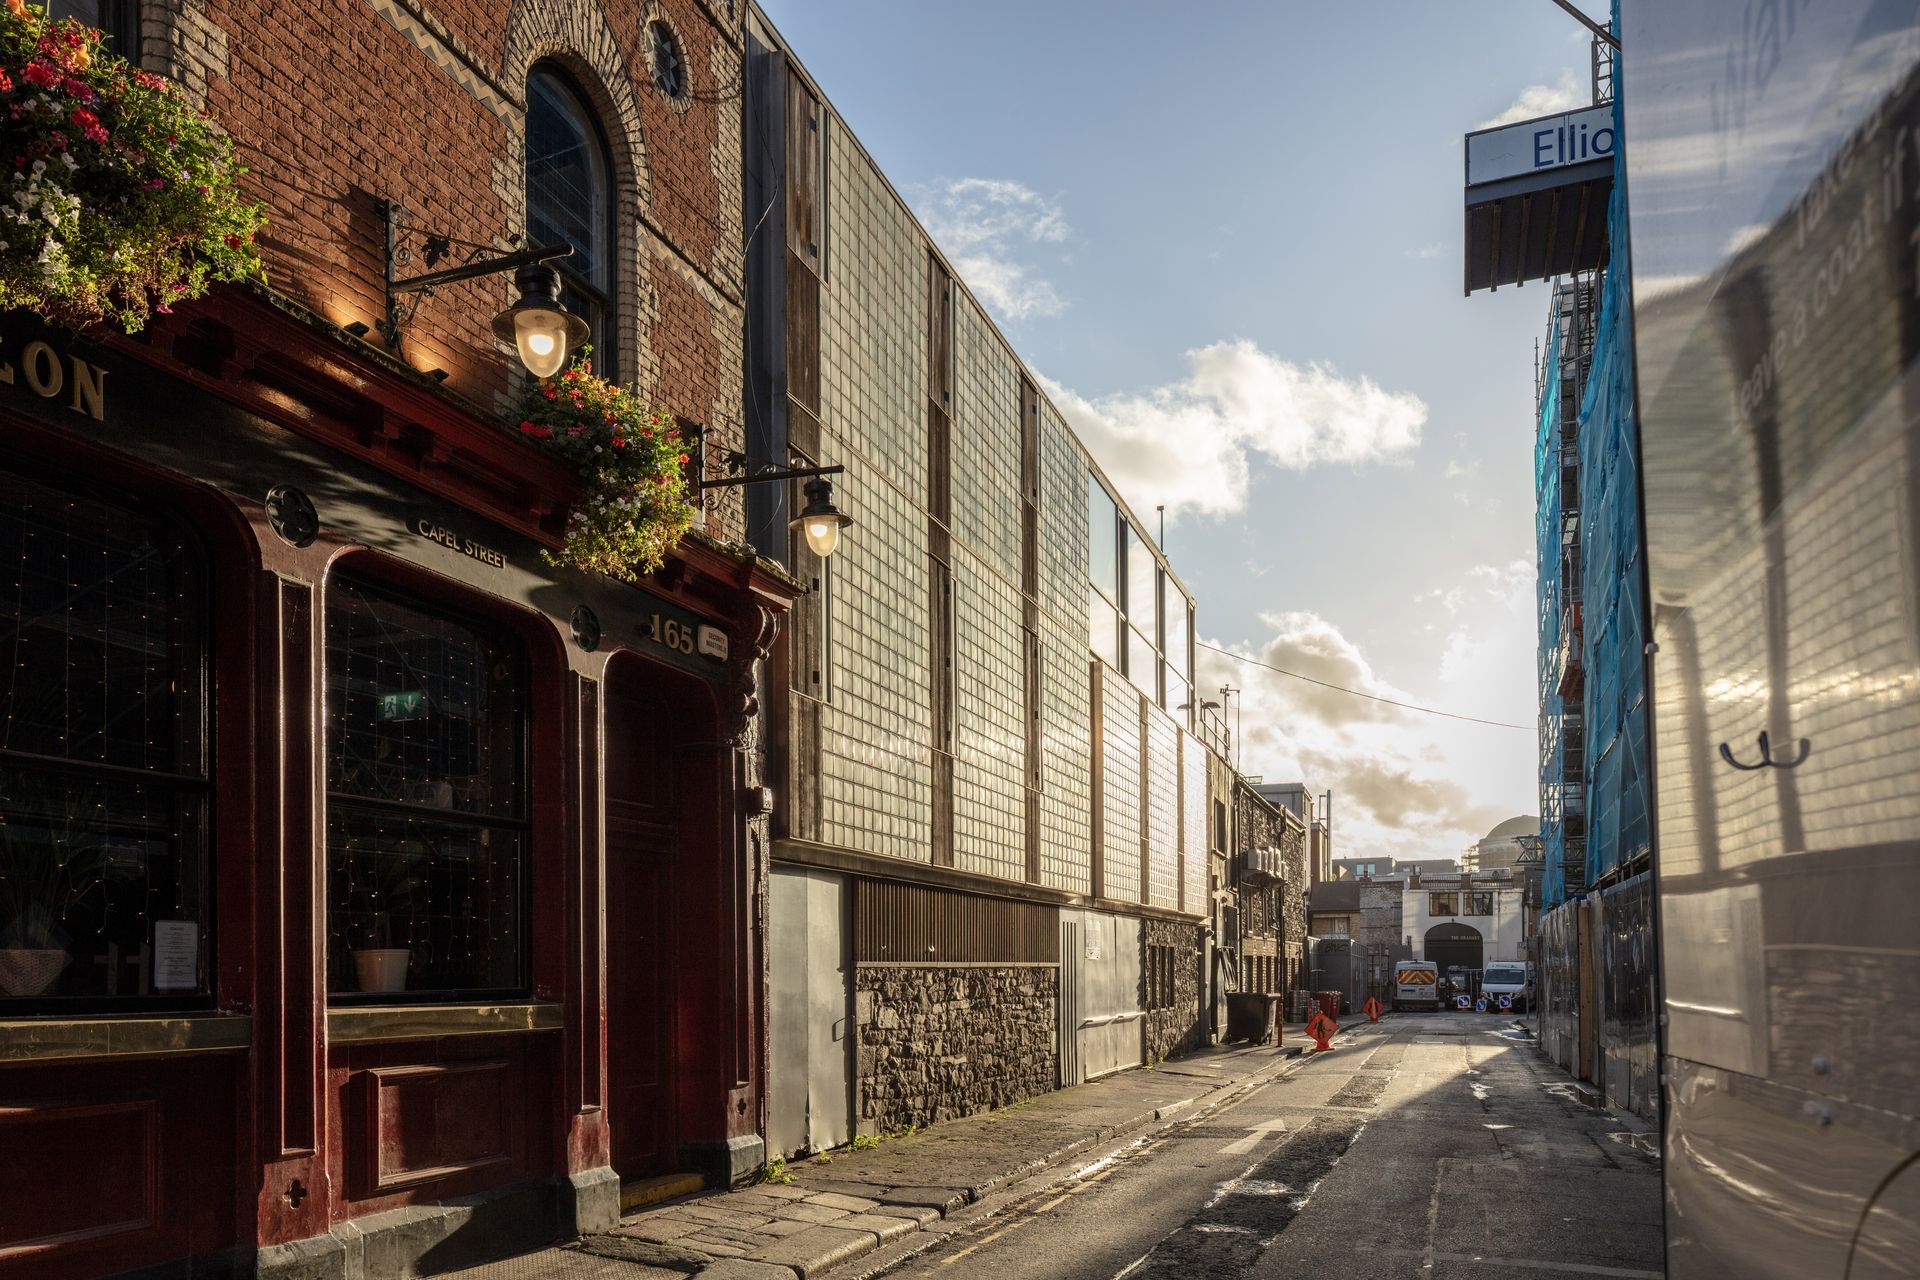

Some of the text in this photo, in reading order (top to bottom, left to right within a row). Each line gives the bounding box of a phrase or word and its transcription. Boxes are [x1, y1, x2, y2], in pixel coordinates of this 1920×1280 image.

[1791, 300, 1807, 348] a
[1812, 191, 1875, 319] coat
[1883, 126, 1907, 223] if
[418, 519, 508, 569] CAPEL STREET
[650, 614, 694, 654] 165
